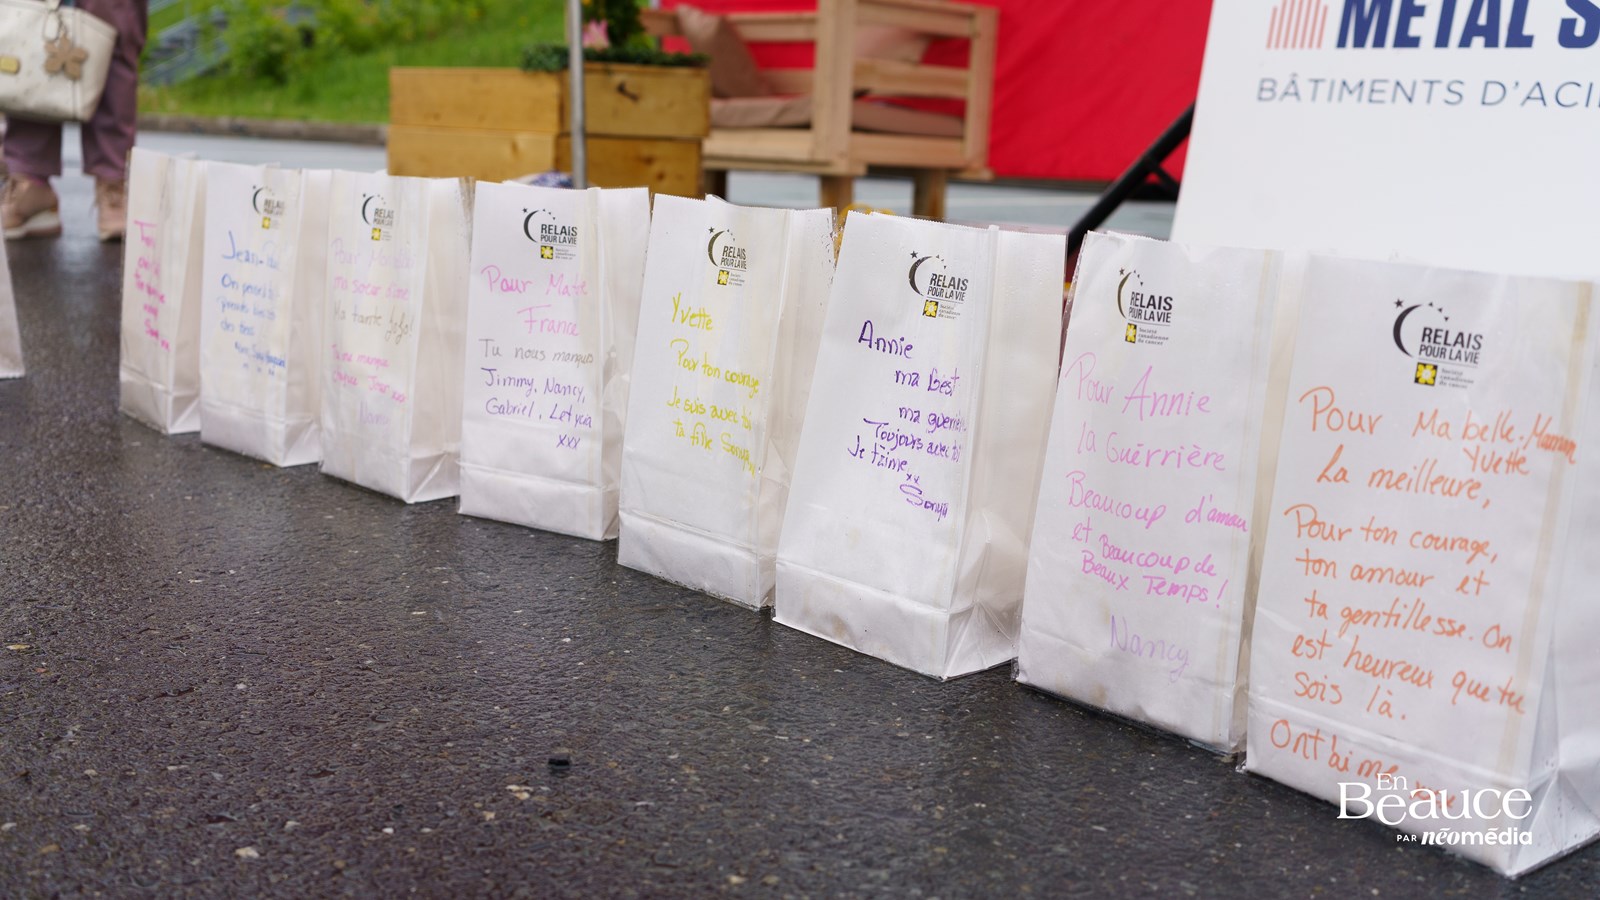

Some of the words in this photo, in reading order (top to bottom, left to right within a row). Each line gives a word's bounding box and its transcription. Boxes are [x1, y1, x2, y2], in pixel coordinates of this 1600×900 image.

[1256, 73, 1465, 106] BÂTIMENTS
[1480, 80, 1600, 108] D'ACI
[540, 223, 578, 237] RELAIS
[540, 234, 557, 243] POUR
[566, 236, 577, 245] VIE
[720, 257, 734, 268] POUR
[739, 260, 747, 270] VIE
[722, 245, 747, 260] RELAIS
[480, 264, 534, 294] Pour
[927, 286, 944, 299] POUR
[944, 288, 955, 299] LA
[954, 290, 966, 302] VIE
[929, 272, 969, 292] RELAIS
[671, 292, 713, 331] Yvette
[1129, 291, 1174, 312] RELAIS
[1129, 306, 1143, 321] POUR
[1144, 309, 1155, 322] LA
[1156, 311, 1172, 324] VIE
[479, 338, 502, 358] Tu
[514, 344, 546, 361] nous
[858, 319, 914, 359] Annie
[1418, 344, 1447, 359] POUR
[1448, 348, 1464, 362] LA
[1464, 351, 1480, 366] VIE
[1421, 326, 1484, 351] RELAIS
[894, 370, 920, 387] ma
[1064, 351, 1115, 405] Pour
[1121, 365, 1212, 422] Annie
[1299, 386, 1383, 435] Pour
[1411, 408, 1453, 440] Ma
[1077, 421, 1097, 455] la
[1316, 443, 1350, 484] La
[1065, 470, 1167, 530] Beaucoup
[1283, 503, 1352, 542] Pour
[1360, 515, 1398, 546] ton
[1071, 516, 1093, 544] et
[1098, 533, 1190, 575] Beaucoup
[1081, 549, 1129, 591] Beaux
[1295, 547, 1337, 579] ton
[1350, 563, 1435, 588] amour
[1455, 570, 1490, 596] et
[1304, 589, 1329, 621] ta
[1482, 623, 1513, 654] On
[1110, 614, 1190, 684] Nancy
[1291, 628, 1334, 660] est
[1343, 634, 1435, 689] heureux
[1451, 670, 1490, 705] que
